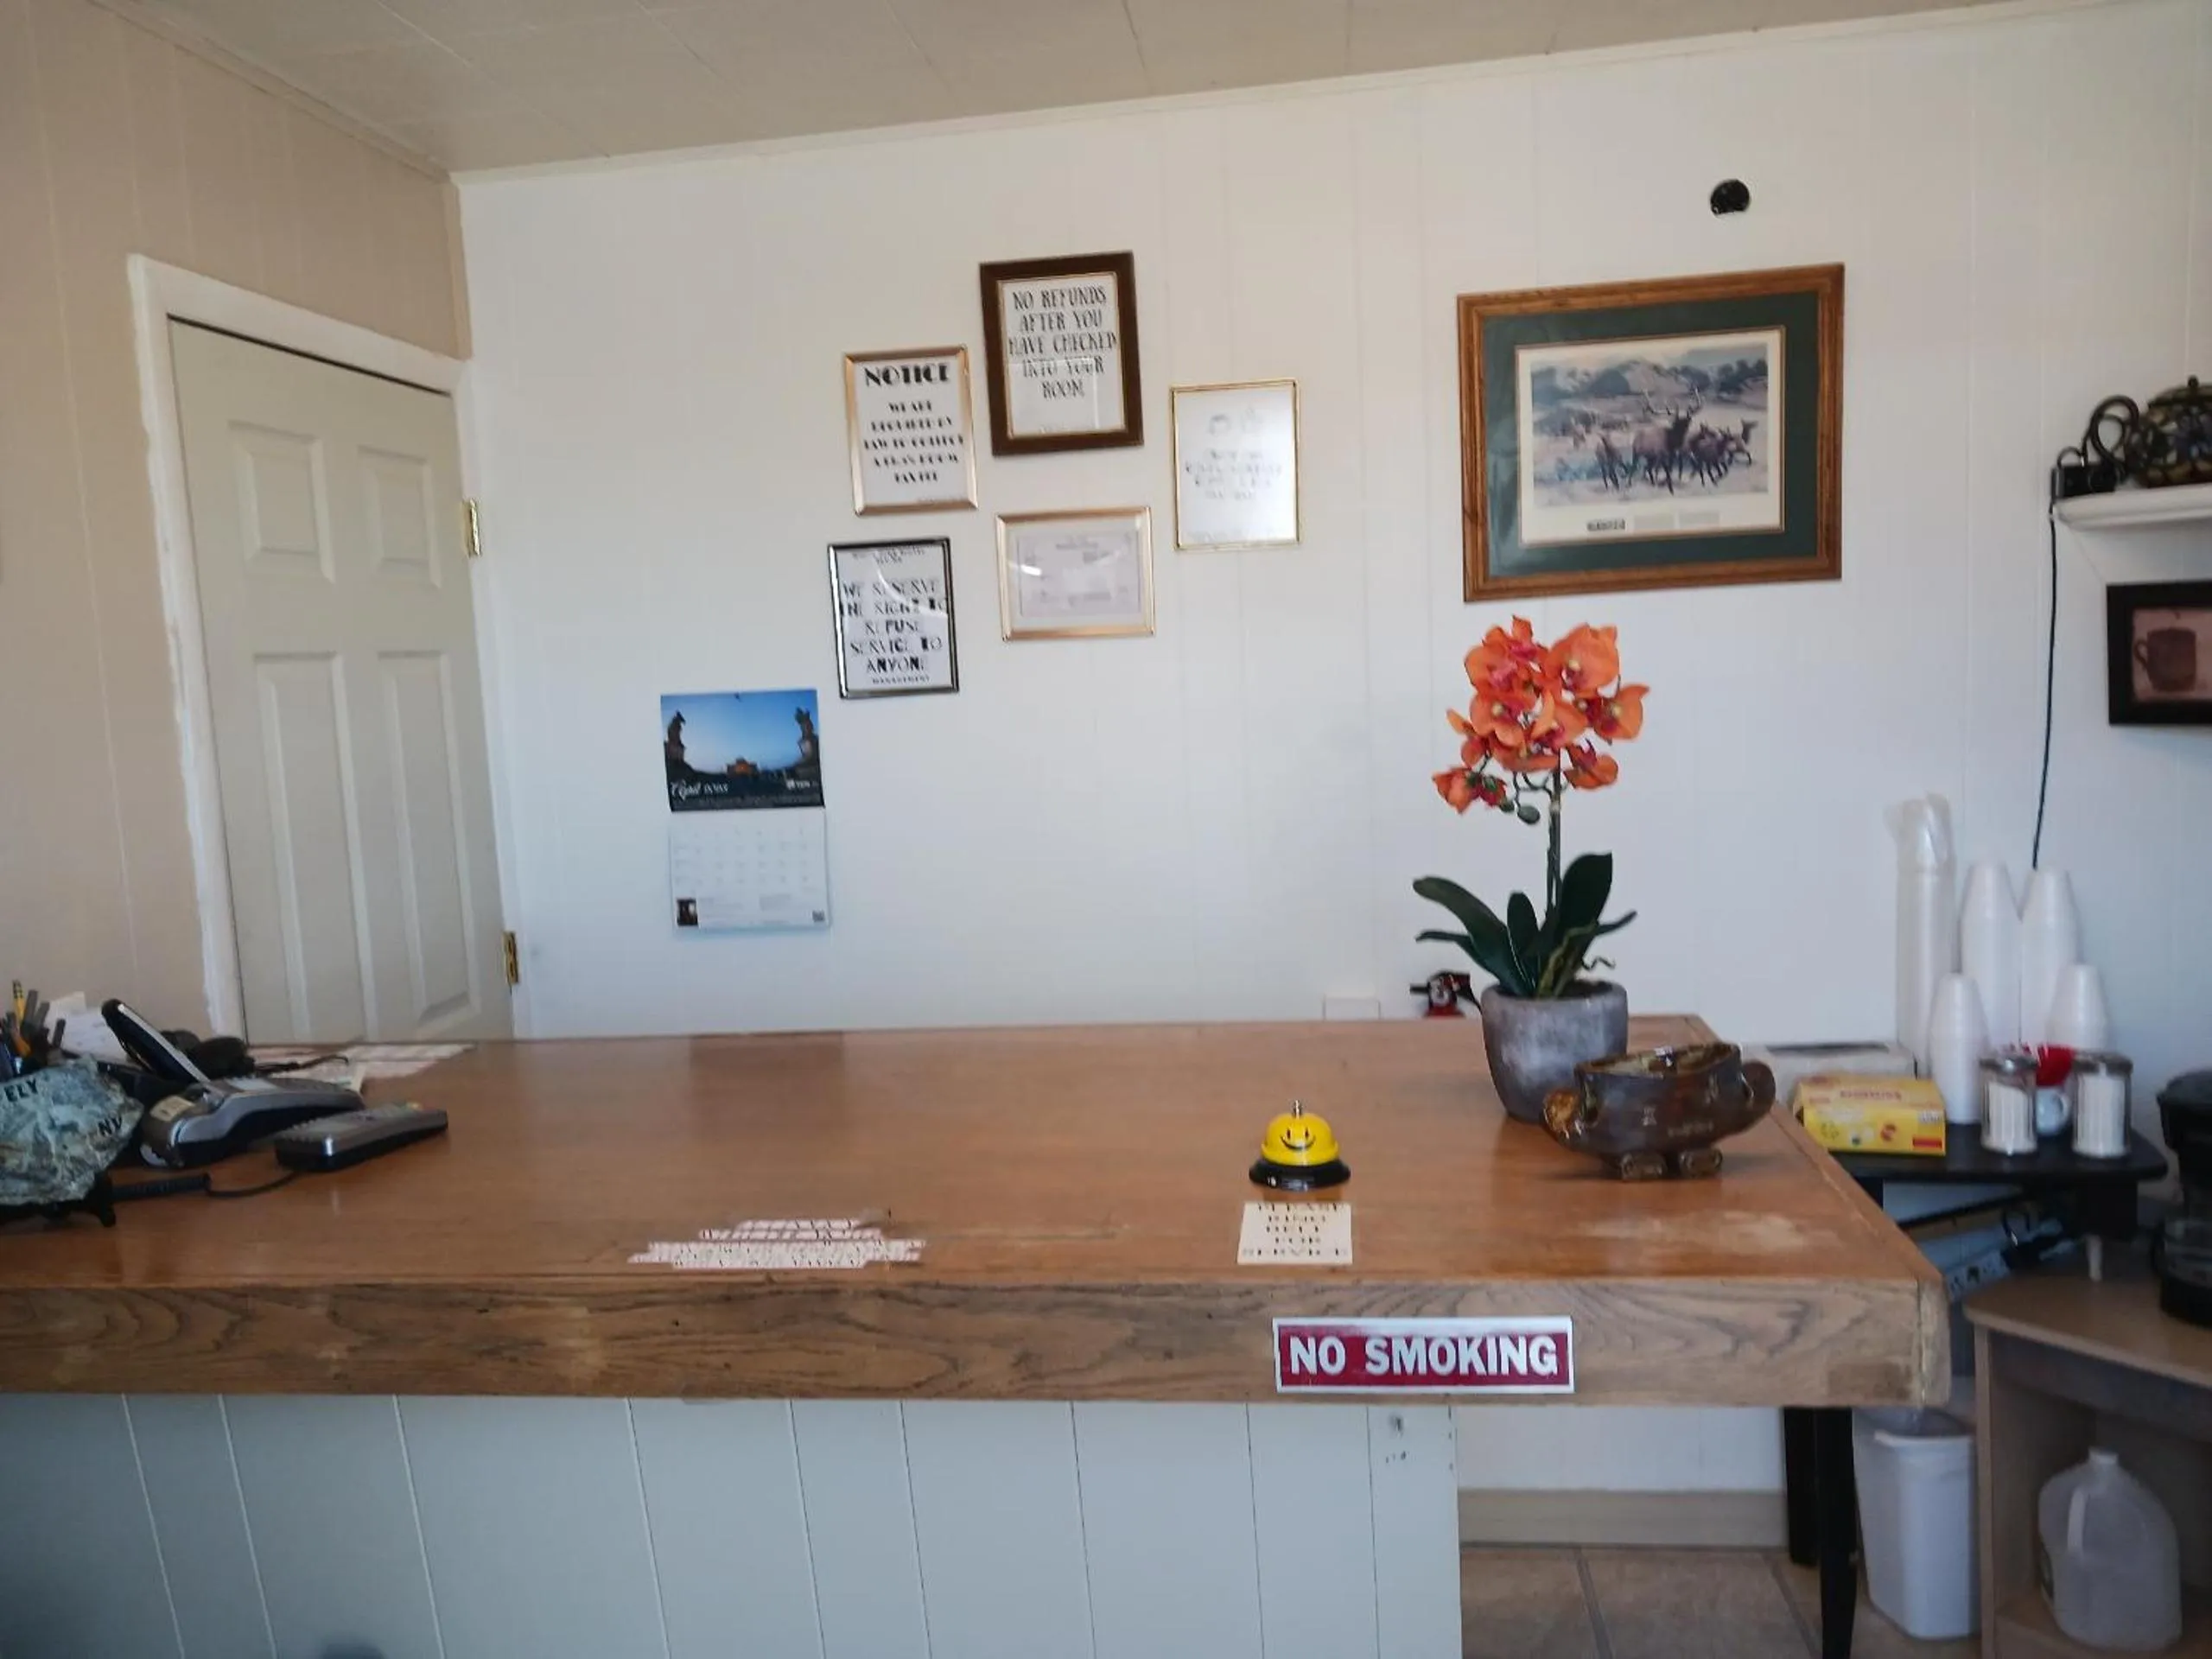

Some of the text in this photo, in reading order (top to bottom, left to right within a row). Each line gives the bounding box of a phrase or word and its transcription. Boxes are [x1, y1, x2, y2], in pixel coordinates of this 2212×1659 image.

[1013, 284, 1108, 311] NO REFUNDS
[1020, 308, 1103, 333] AFTER YOU
[1008, 331, 1118, 355] HAVE CHECKED
[864, 363, 951, 387] NOTICE
[1022, 355, 1105, 378] INTO YOUR
[1041, 378, 1086, 400] ROOM
[3, 1078, 39, 1103] ELY
[98, 1116, 124, 1136] NV
[1290, 1335, 1559, 1376] NO SMOKING
